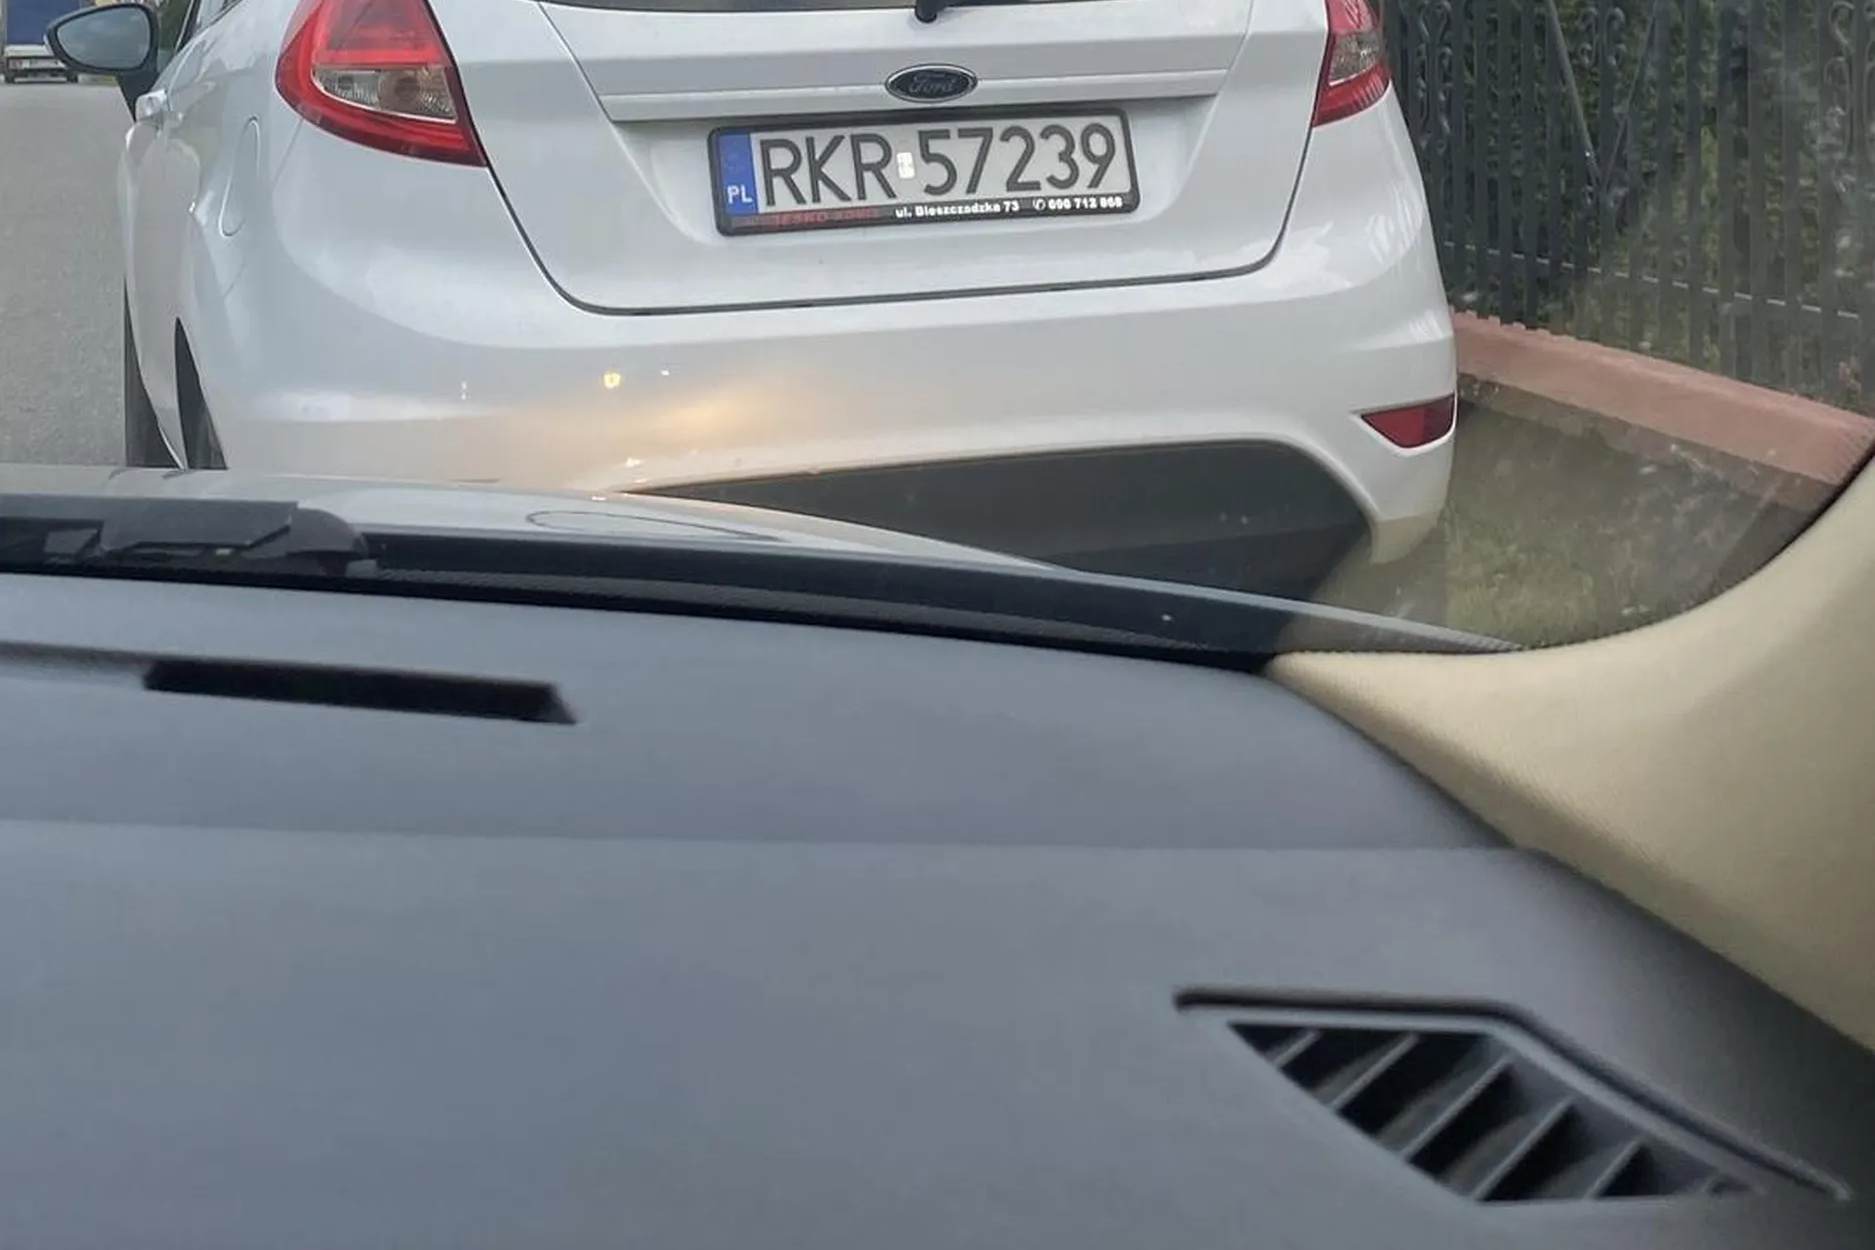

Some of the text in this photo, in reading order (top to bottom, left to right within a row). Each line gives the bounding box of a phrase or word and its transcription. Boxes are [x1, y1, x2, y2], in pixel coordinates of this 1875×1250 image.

[759, 123, 1116, 207] RKR 57239
[727, 185, 753, 204] PL
[895, 206, 913, 218] ul.
[1002, 199, 1020, 213] 73
